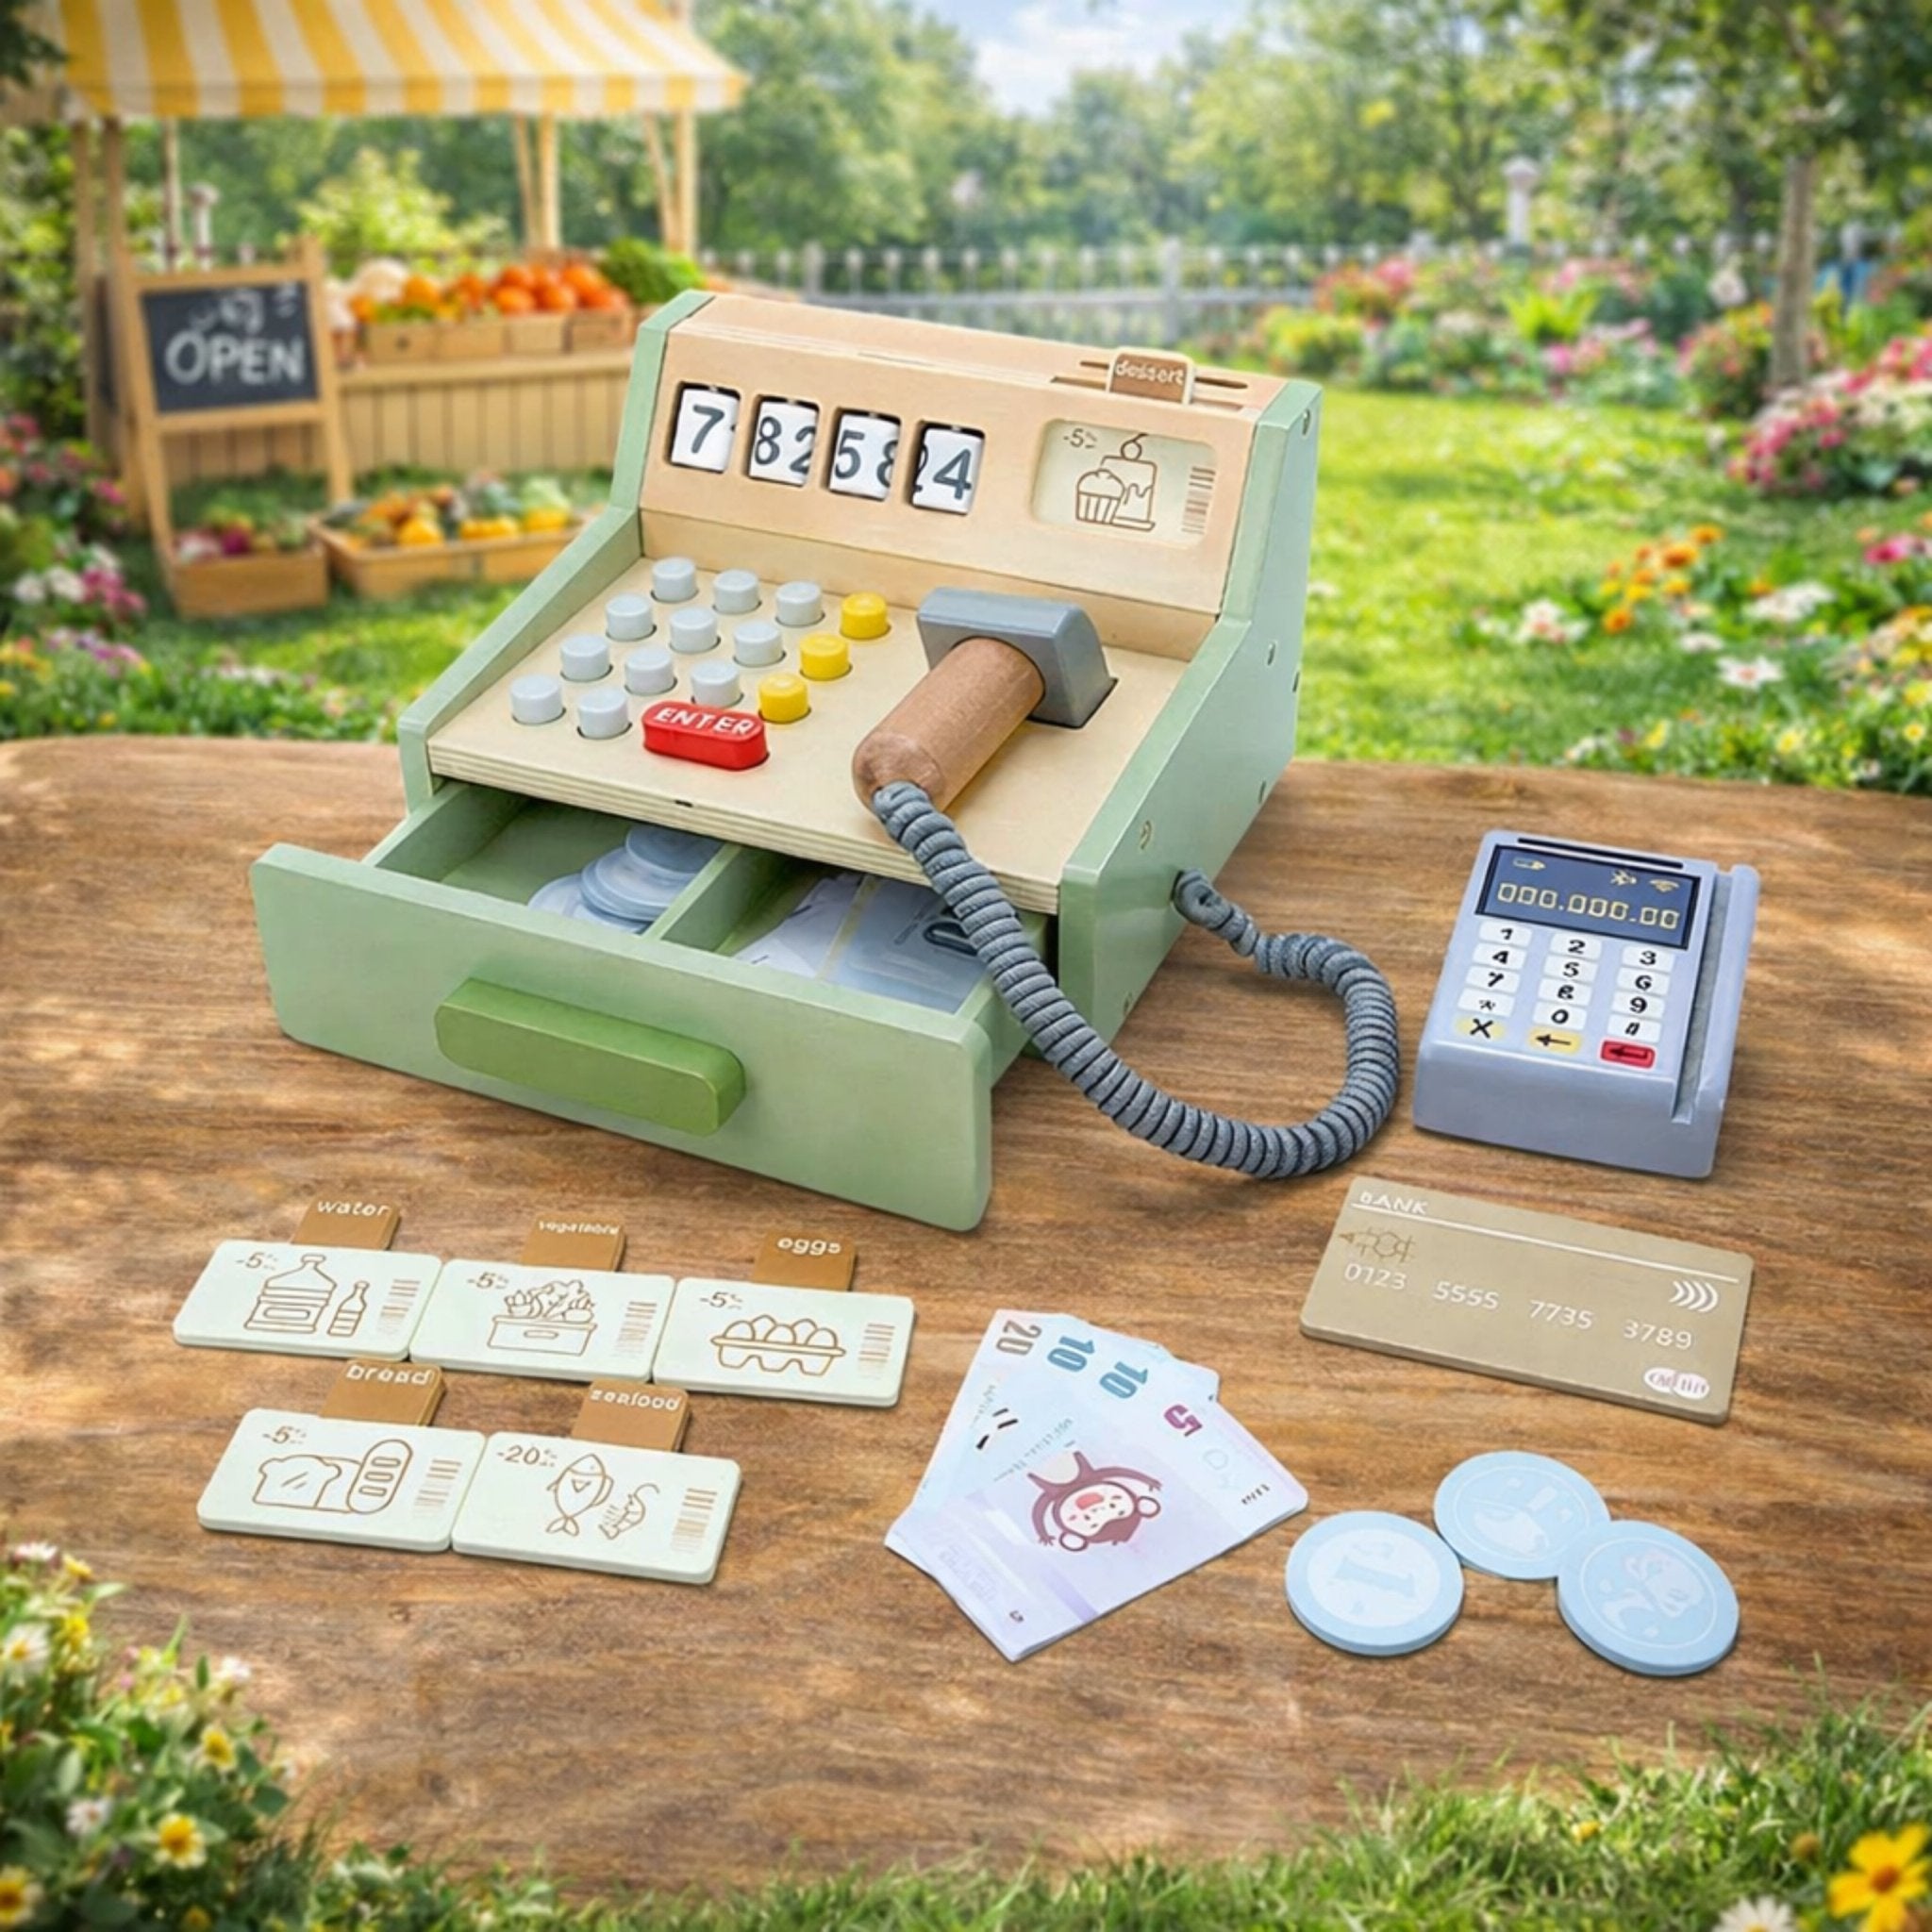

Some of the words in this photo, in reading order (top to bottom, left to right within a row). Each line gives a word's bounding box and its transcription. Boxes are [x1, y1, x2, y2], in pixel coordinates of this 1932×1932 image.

[164, 329, 305, 385] OPEN
[691, 404, 725, 455] 7
[654, 707, 754, 735] ENTER
[1491, 950, 1509, 964] 4
[1562, 961, 1580, 978] 5
[1634, 974, 1653, 991] 6
[1568, 939, 1586, 955] 2
[1640, 950, 1657, 967] 3
[1487, 971, 1505, 988] 7
[1629, 996, 1648, 1014] 9
[1550, 1008, 1570, 1025] 0
[1358, 1191, 1429, 1216] BANK
[777, 1237, 841, 1256] eggs
[1344, 1262, 1407, 1291] 0123
[1432, 1280, 1500, 1310] 5555
[1529, 1299, 1594, 1330] 7735
[1623, 1320, 1692, 1351] 3789
[995, 1320, 1042, 1357] 20
[1046, 1335, 1095, 1373] 10
[1098, 1361, 1149, 1399] 10
[1162, 1404, 1203, 1438] 5
